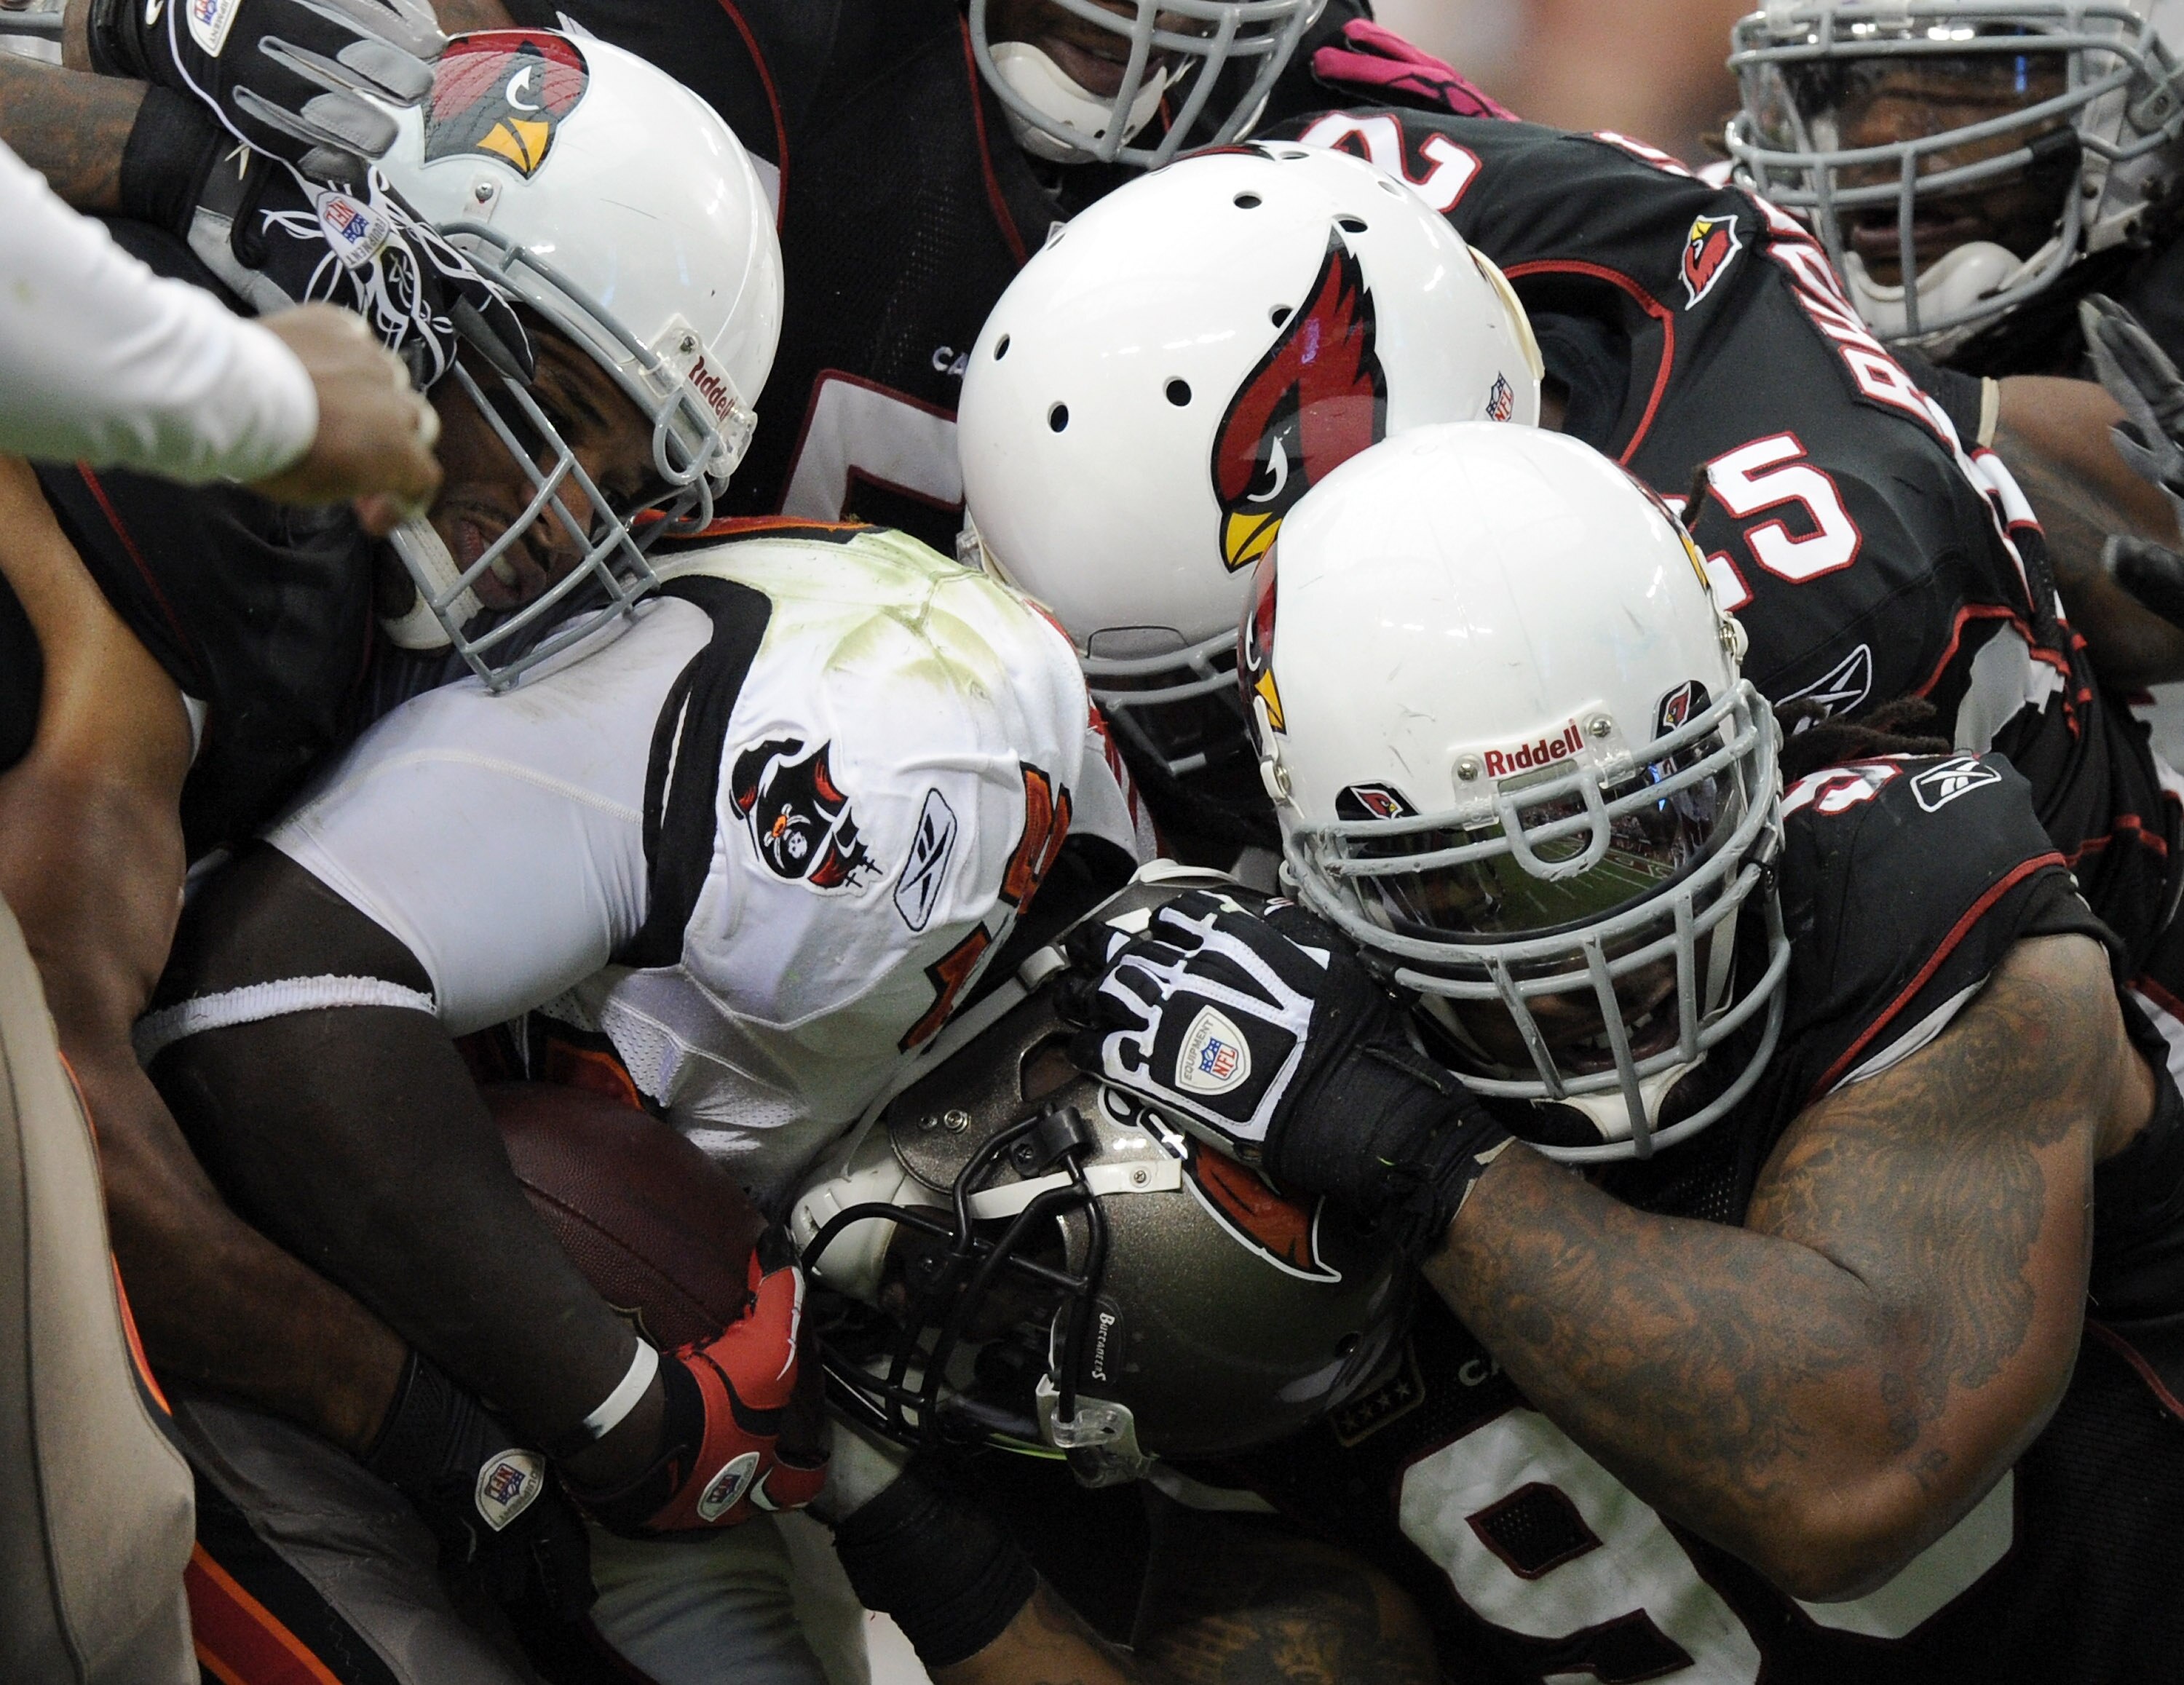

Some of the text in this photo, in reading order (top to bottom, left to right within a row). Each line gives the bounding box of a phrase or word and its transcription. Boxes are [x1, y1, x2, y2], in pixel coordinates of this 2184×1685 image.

[326, 199, 355, 229] NFL
[346, 217, 387, 266] EQUIPMENT
[1484, 724, 1584, 777] Riddell
[1184, 1020, 1214, 1081] EQUIPMENT
[1212, 1049, 1237, 1077] NFL
[490, 1466, 514, 1495] NFL
